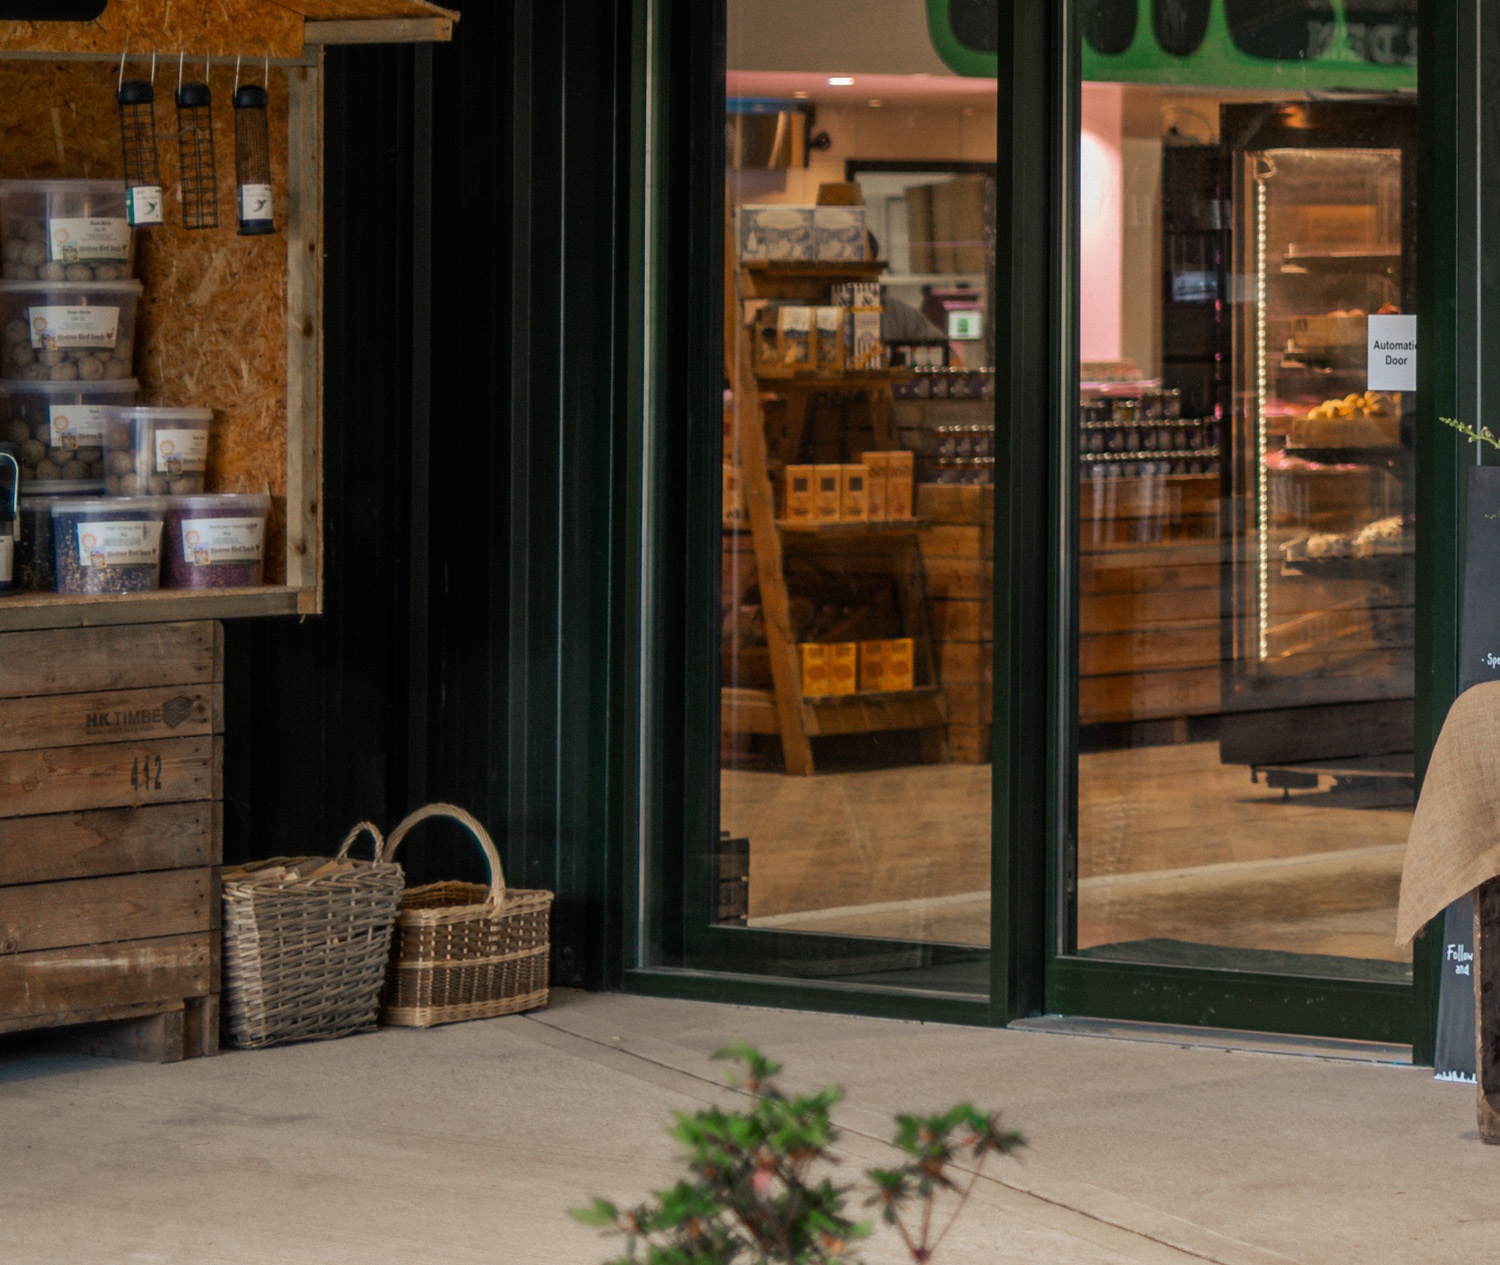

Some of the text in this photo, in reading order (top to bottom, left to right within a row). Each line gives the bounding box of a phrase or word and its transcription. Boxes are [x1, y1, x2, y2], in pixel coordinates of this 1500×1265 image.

[1385, 355, 1408, 365] Door
[1447, 944, 1474, 962] Follow
[1455, 964, 1470, 976] and
